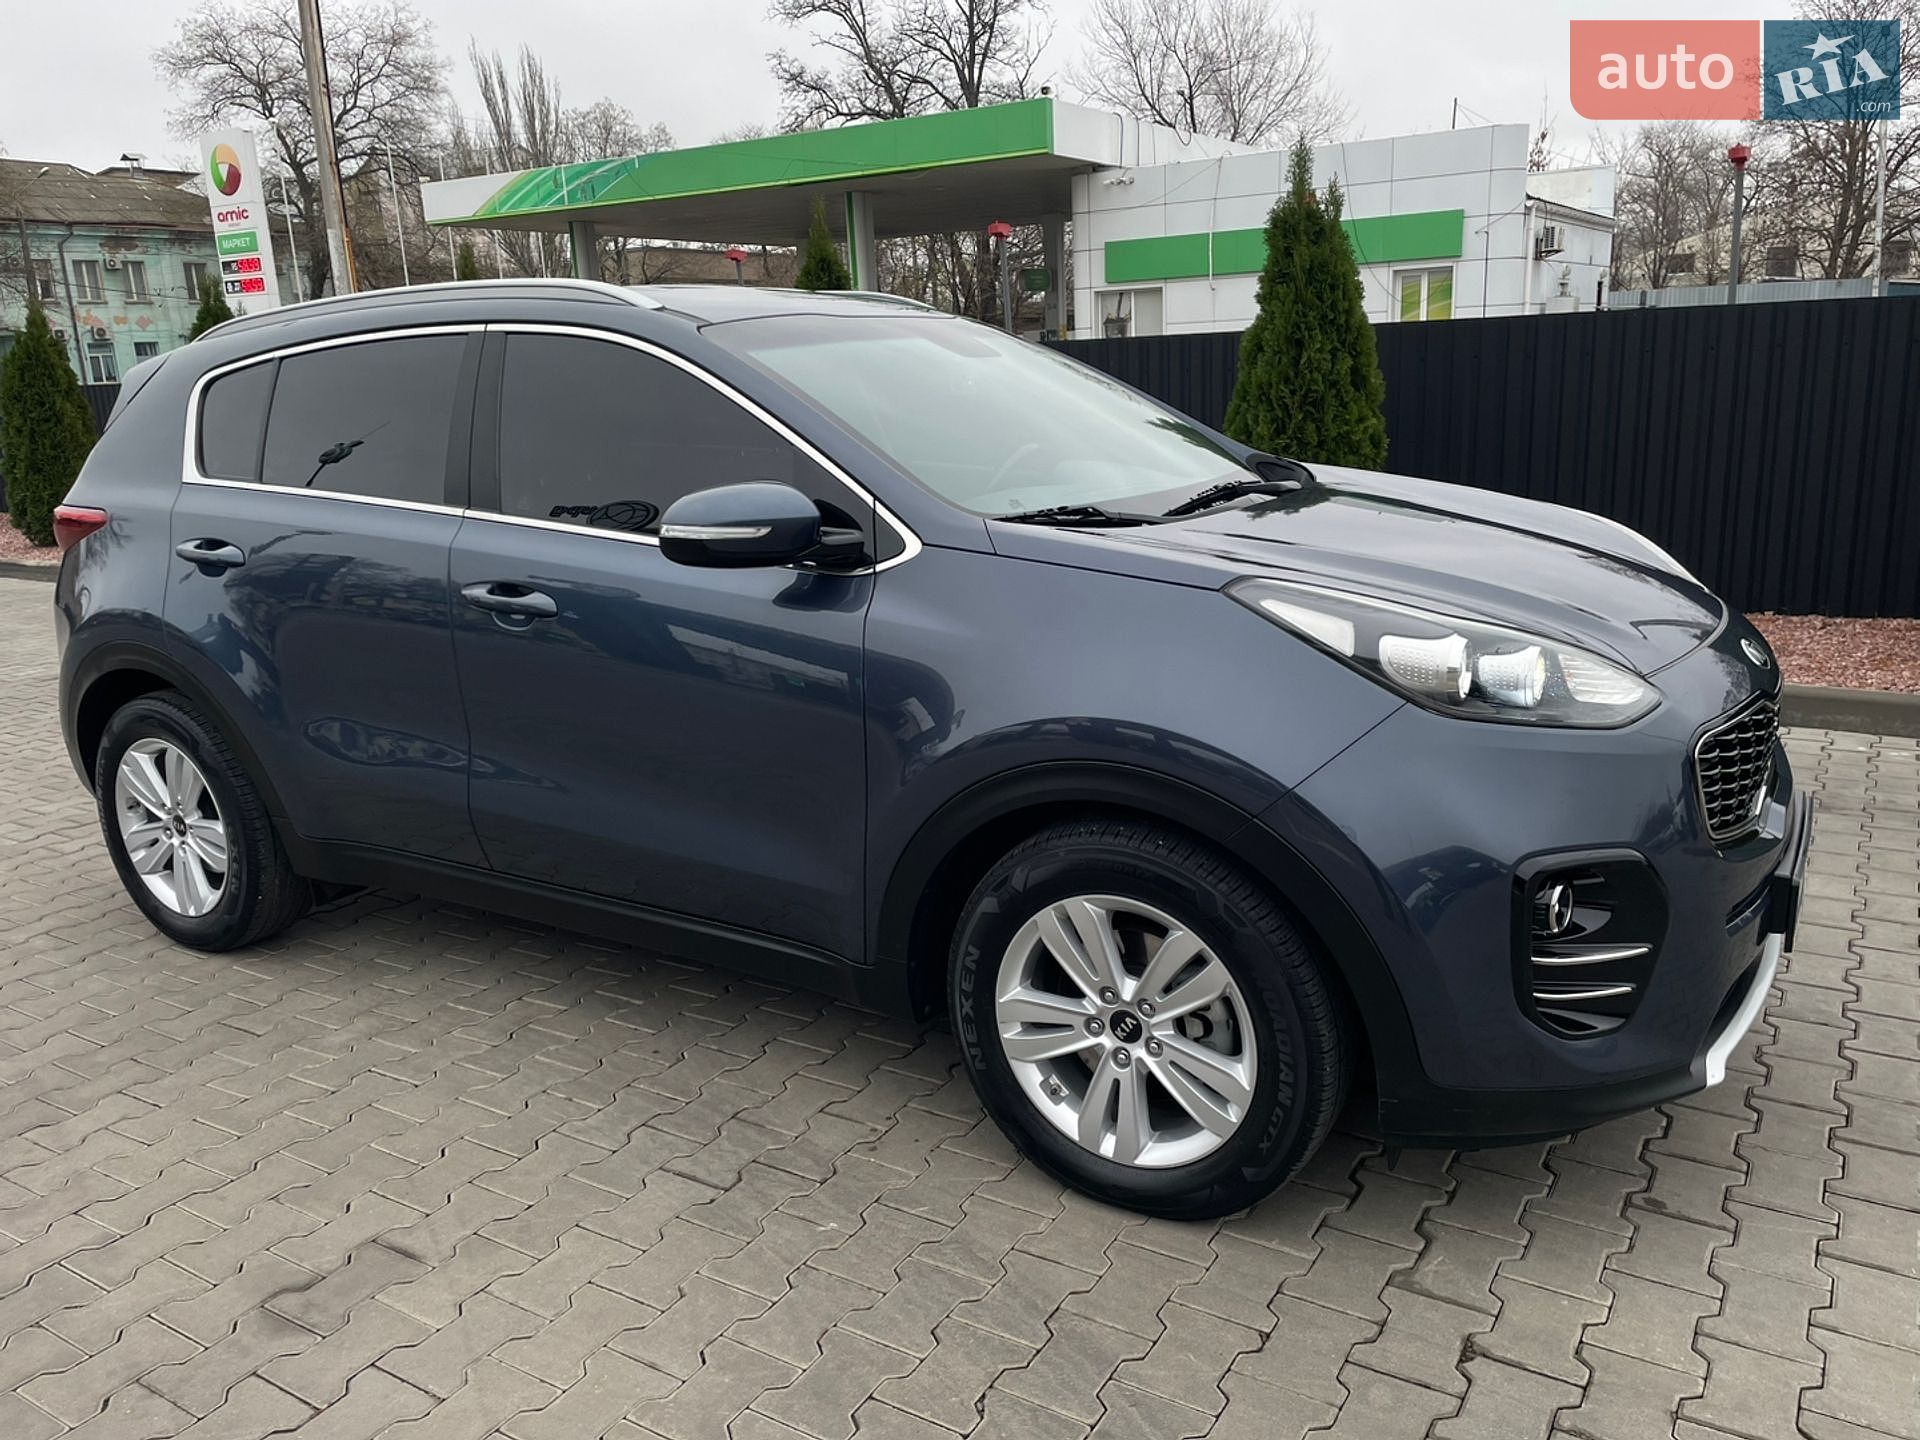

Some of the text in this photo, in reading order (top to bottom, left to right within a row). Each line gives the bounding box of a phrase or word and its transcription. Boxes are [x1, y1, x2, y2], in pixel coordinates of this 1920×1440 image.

[217, 206, 249, 222] amic
[222, 237, 250, 249] МАРКЕТ
[961, 944, 987, 1070] NEXEN
[1114, 1017, 1137, 1040] KIA
